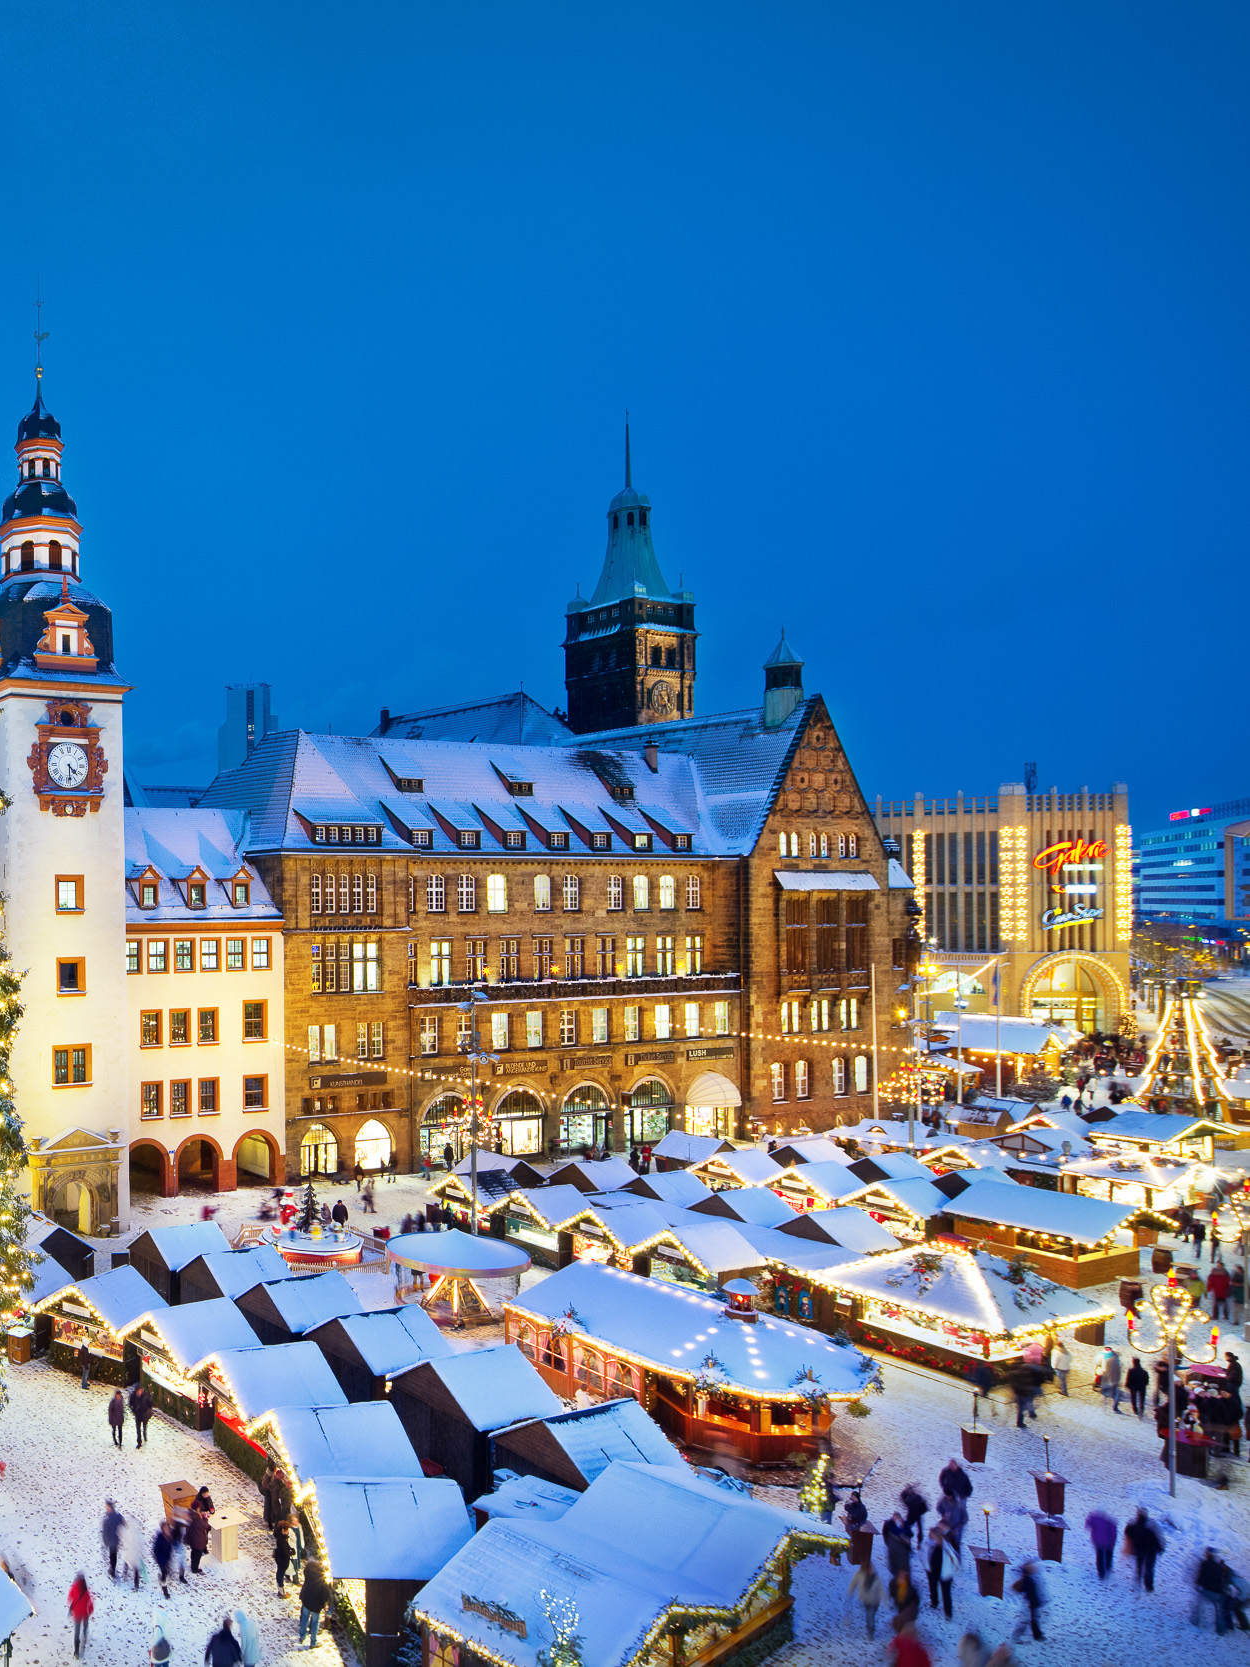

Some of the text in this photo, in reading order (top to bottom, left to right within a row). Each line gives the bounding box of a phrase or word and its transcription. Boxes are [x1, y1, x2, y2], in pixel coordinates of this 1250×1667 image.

[1033, 838, 1112, 875] Galerie
[593, 1056, 612, 1064] Service
[656, 1052, 674, 1060] Service
[330, 1080, 364, 1088] KUNSTHANDEL
